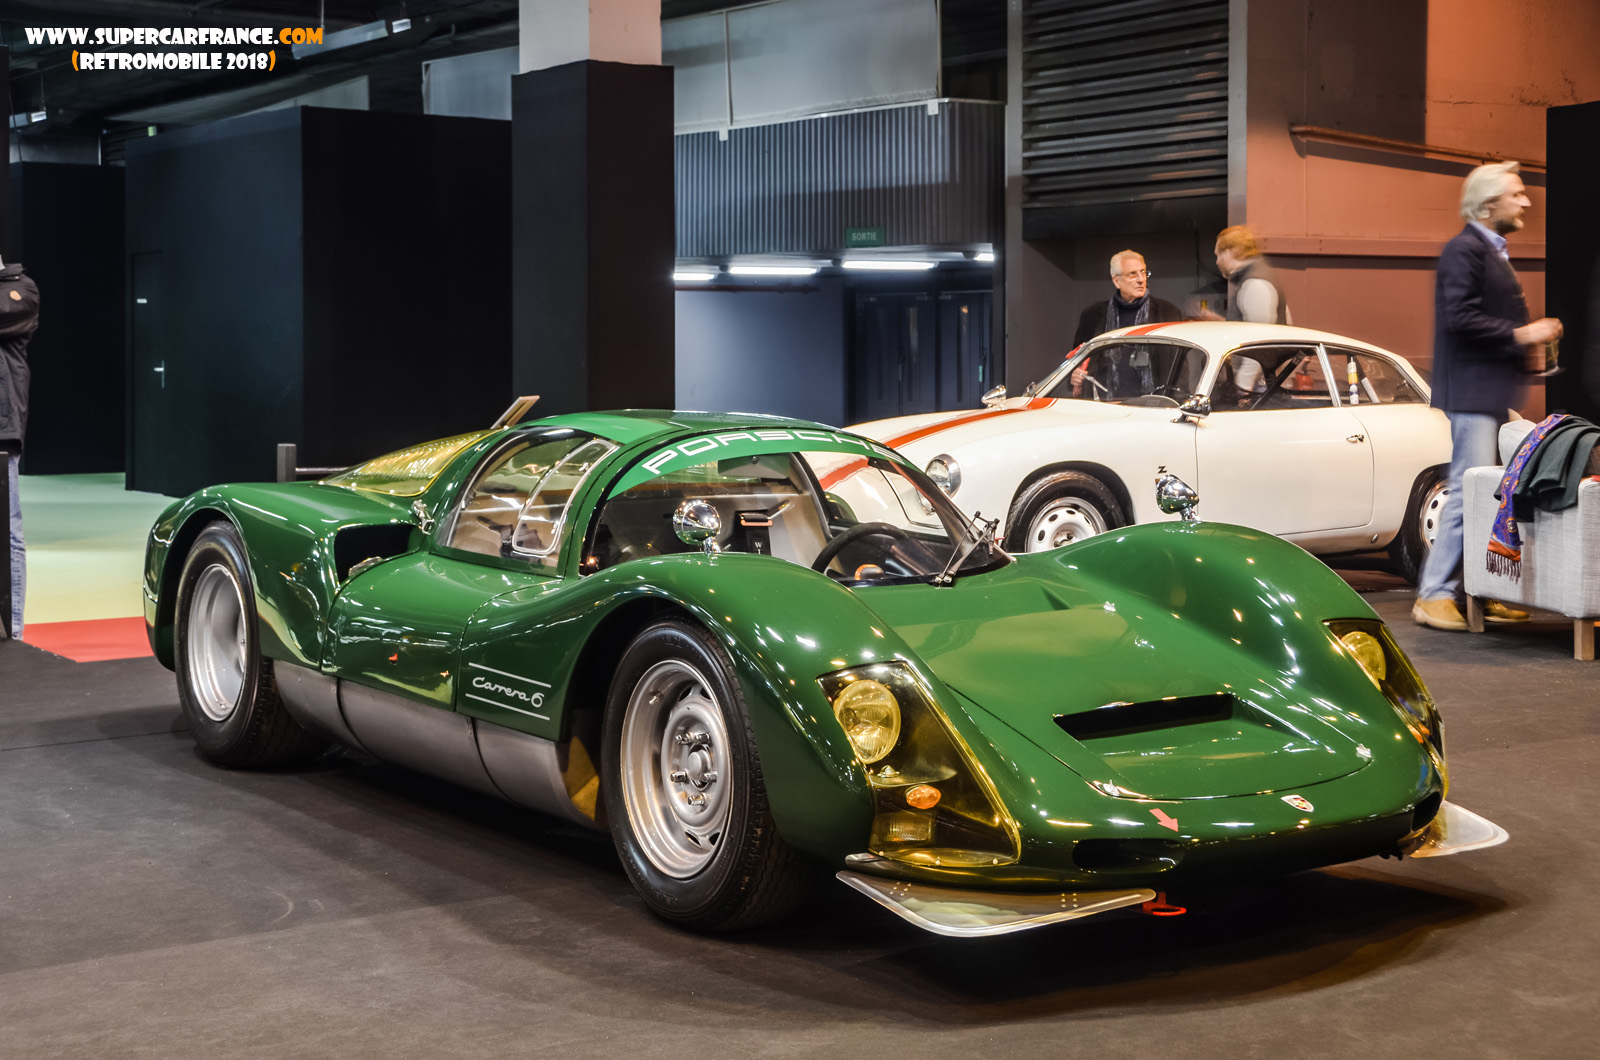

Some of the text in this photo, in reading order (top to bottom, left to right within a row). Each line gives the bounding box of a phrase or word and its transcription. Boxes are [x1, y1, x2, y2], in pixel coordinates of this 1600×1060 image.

[852, 232, 877, 241] SORTIE
[642, 430, 905, 475] PORSCHE
[472, 677, 544, 708] Carrera 6
